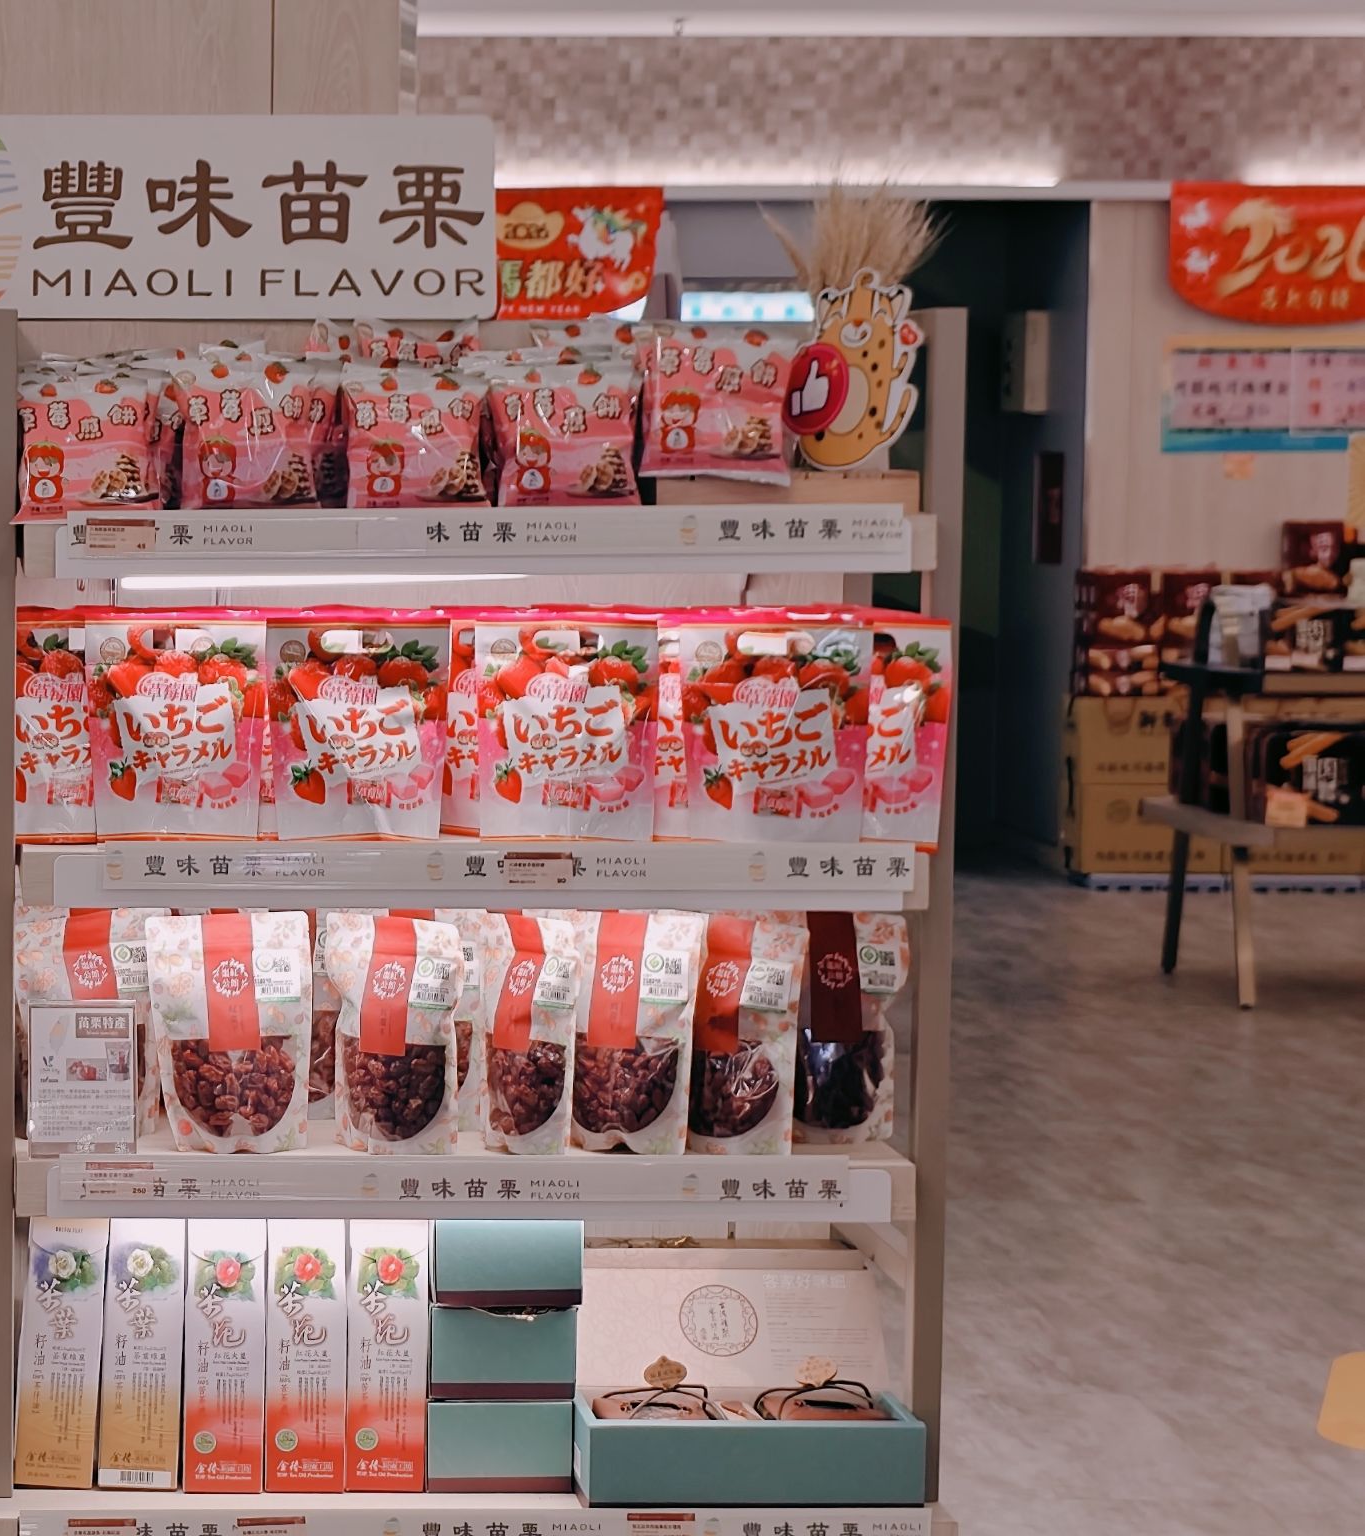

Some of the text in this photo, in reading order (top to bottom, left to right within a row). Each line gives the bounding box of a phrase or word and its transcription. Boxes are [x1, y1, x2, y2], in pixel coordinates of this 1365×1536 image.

[33, 159, 485, 250] 豐味苗栗
[33, 267, 486, 297] MIAOLI FLAVOR
[203, 525, 253, 533] MIAOLI
[203, 537, 253, 545] FLAVOR
[427, 521, 516, 543] 味苗栗
[526, 522, 578, 530] MIAOLI
[526, 535, 578, 543] FLAVOR
[718, 518, 842, 541] 豐味苗栗
[144, 681, 199, 702] 草莓園
[16, 704, 89, 743] いち
[123, 696, 229, 740] いちご
[305, 699, 410, 744] いちご
[512, 699, 619, 744] いちご
[720, 702, 829, 749] いちご
[133, 738, 233, 770] キャラメル
[317, 740, 417, 774] キャラメル
[518, 742, 623, 774] キャラメル
[728, 745, 832, 781] キャラメル
[144, 855, 265, 877] 豐味苗栗
[596, 857, 647, 865] MIAOLI
[596, 869, 647, 878] FLAVOR
[787, 855, 911, 878] 豐味苗栗
[78, 1016, 128, 1030] 苗栗特產
[210, 1179, 260, 1187] MIAOLI
[399, 1177, 521, 1200] 豐味苗栗
[530, 1179, 580, 1187] MIAOLI
[531, 1192, 580, 1200] FLAVOR
[719, 1178, 842, 1200] 豐味苗栗
[36, 1277, 78, 1339] 茶葉
[116, 1277, 159, 1339] 茶葉
[196, 1282, 246, 1347] 茶花
[277, 1281, 327, 1345] 茶花
[360, 1280, 410, 1345] 茶花
[34, 1333, 48, 1366] 籽油
[114, 1333, 128, 1366] 籽油
[197, 1339, 209, 1373] 籽油
[278, 1338, 291, 1372] 籽油
[359, 1337, 372, 1370] 籽油
[552, 1523, 601, 1531] MIAOLI
[872, 1523, 922, 1531] MIAOLI
